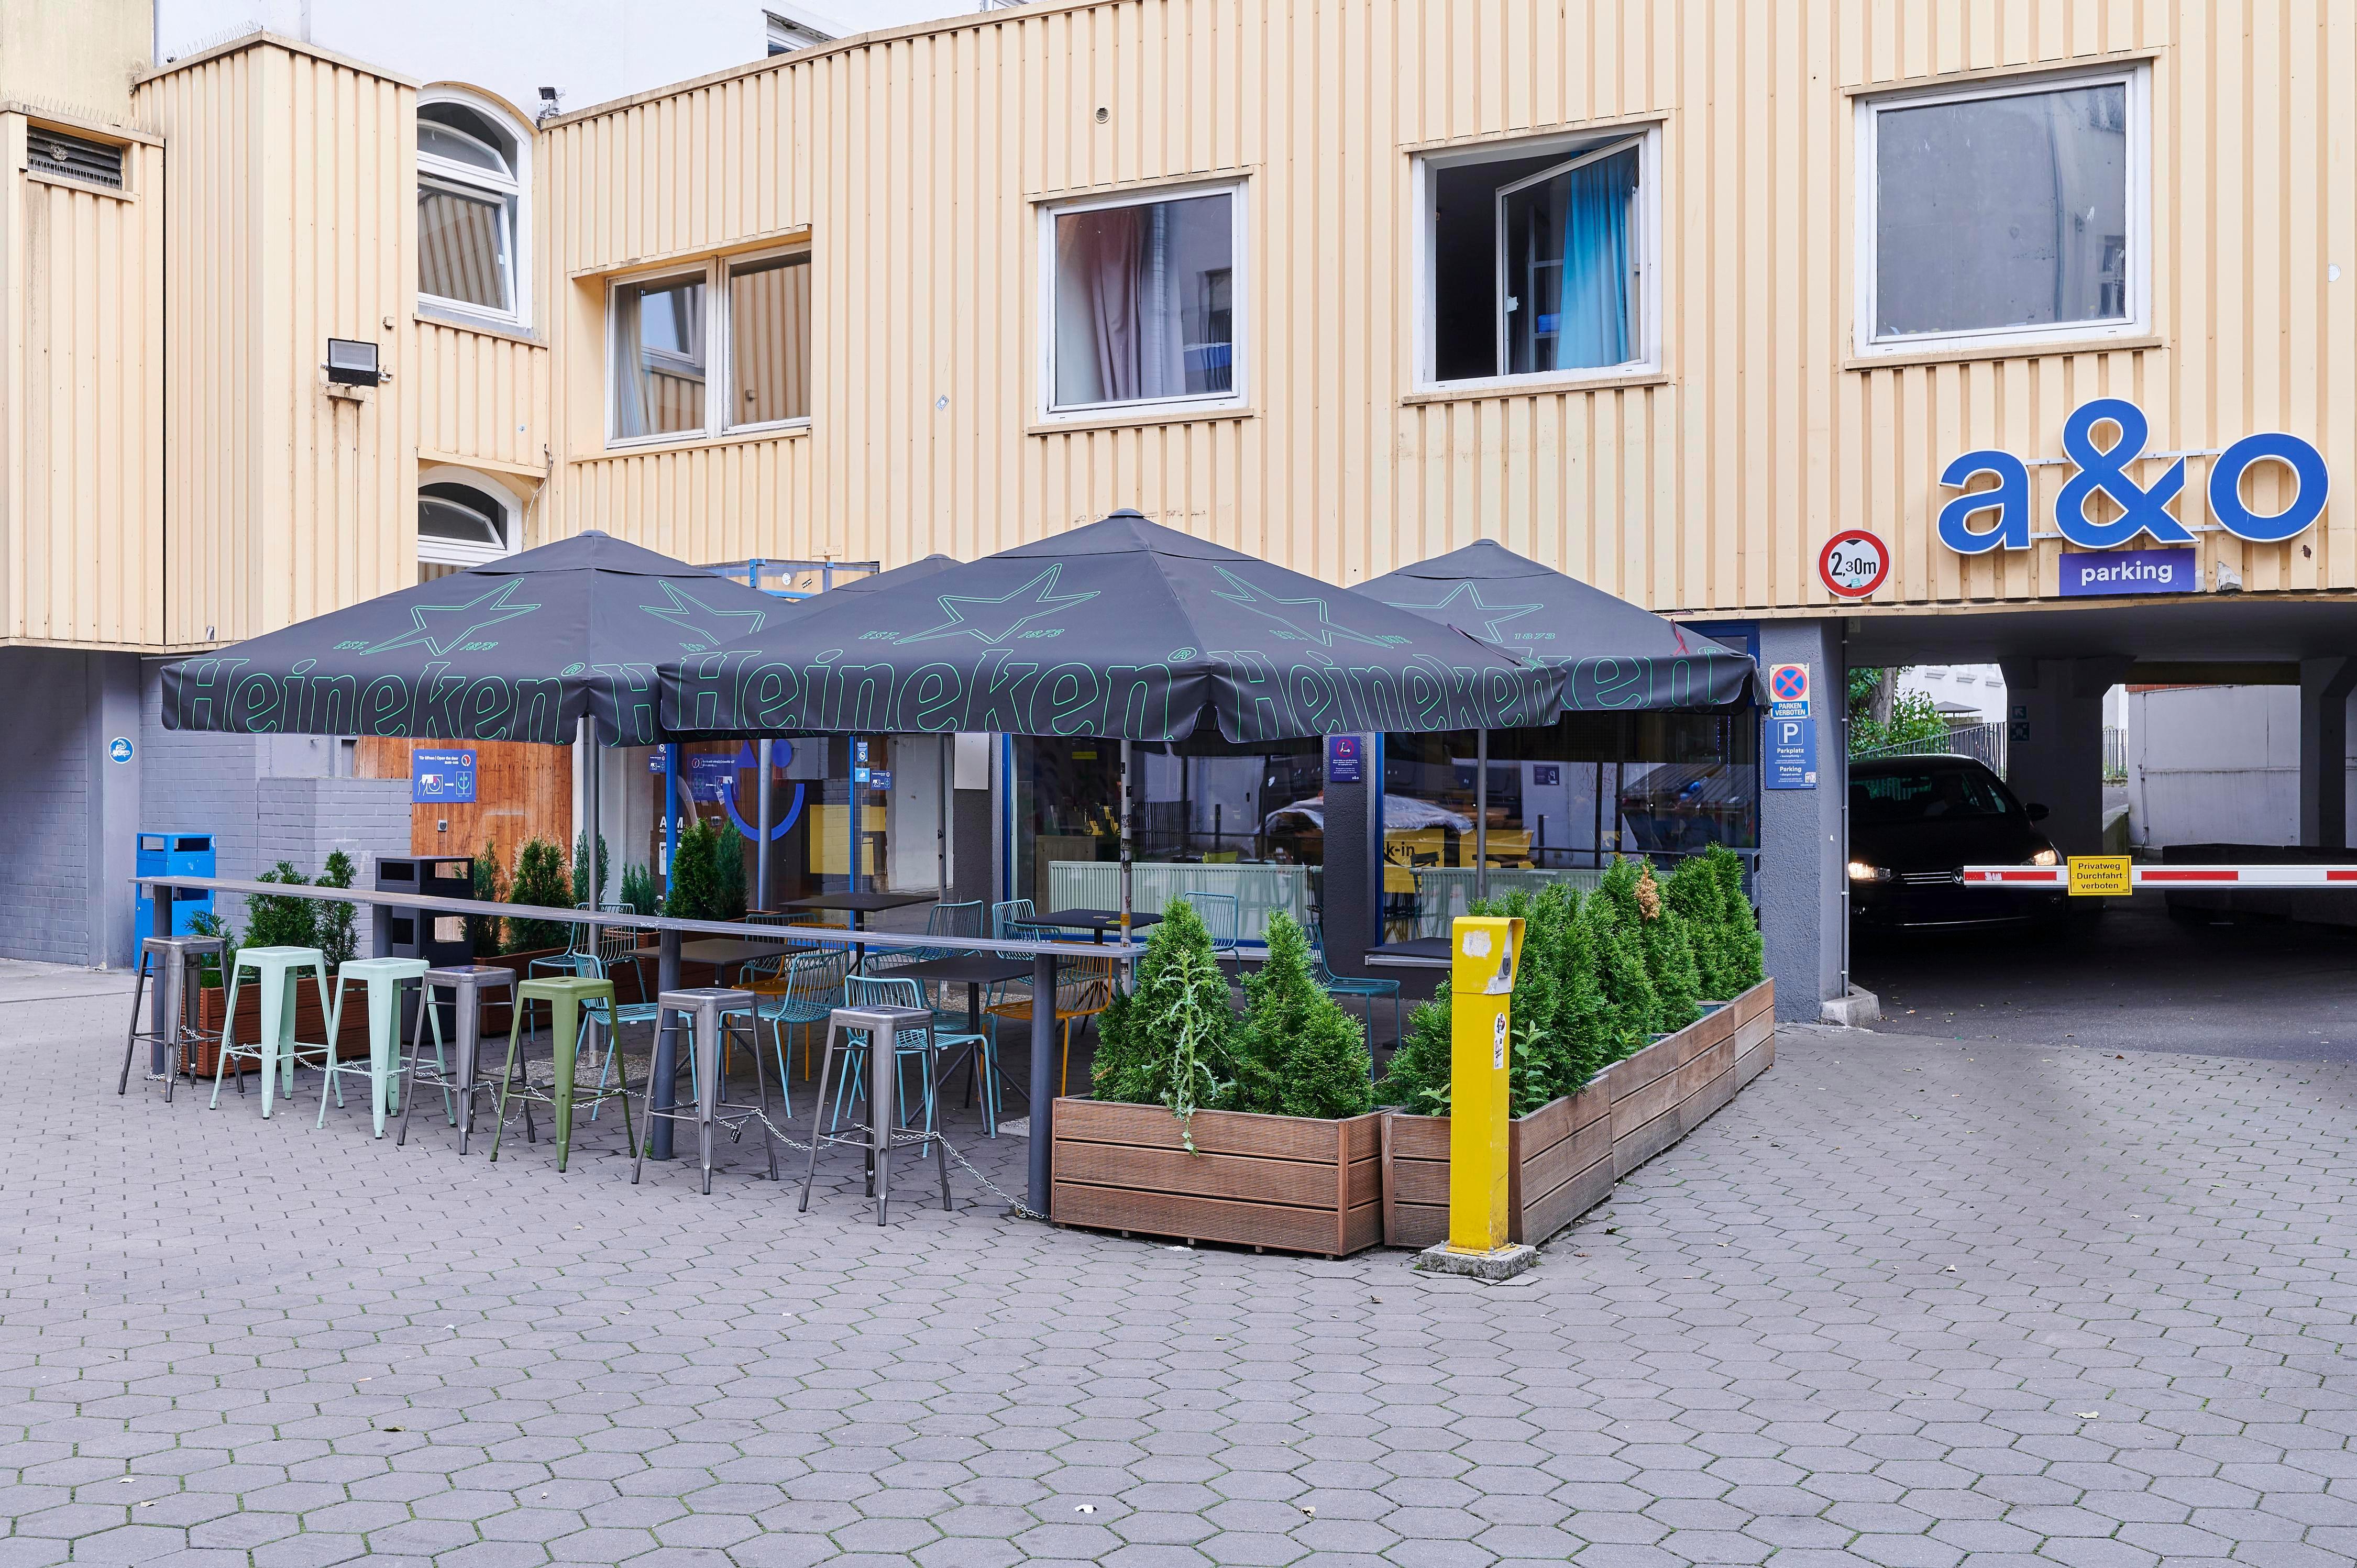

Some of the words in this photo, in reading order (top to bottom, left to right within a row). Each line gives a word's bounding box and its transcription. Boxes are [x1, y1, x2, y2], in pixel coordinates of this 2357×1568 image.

[1936, 397, 2331, 556] a&o
[1831, 551, 1877, 577] 2,30m
[2081, 560, 2173, 587] parking
[459, 642, 499, 650] 1873
[1017, 628, 1065, 638] 1873
[177, 658, 567, 745] Heineken
[675, 648, 1174, 741] Heineken
[1206, 649, 1558, 742] Heineken
[1783, 723, 1799, 744] P
